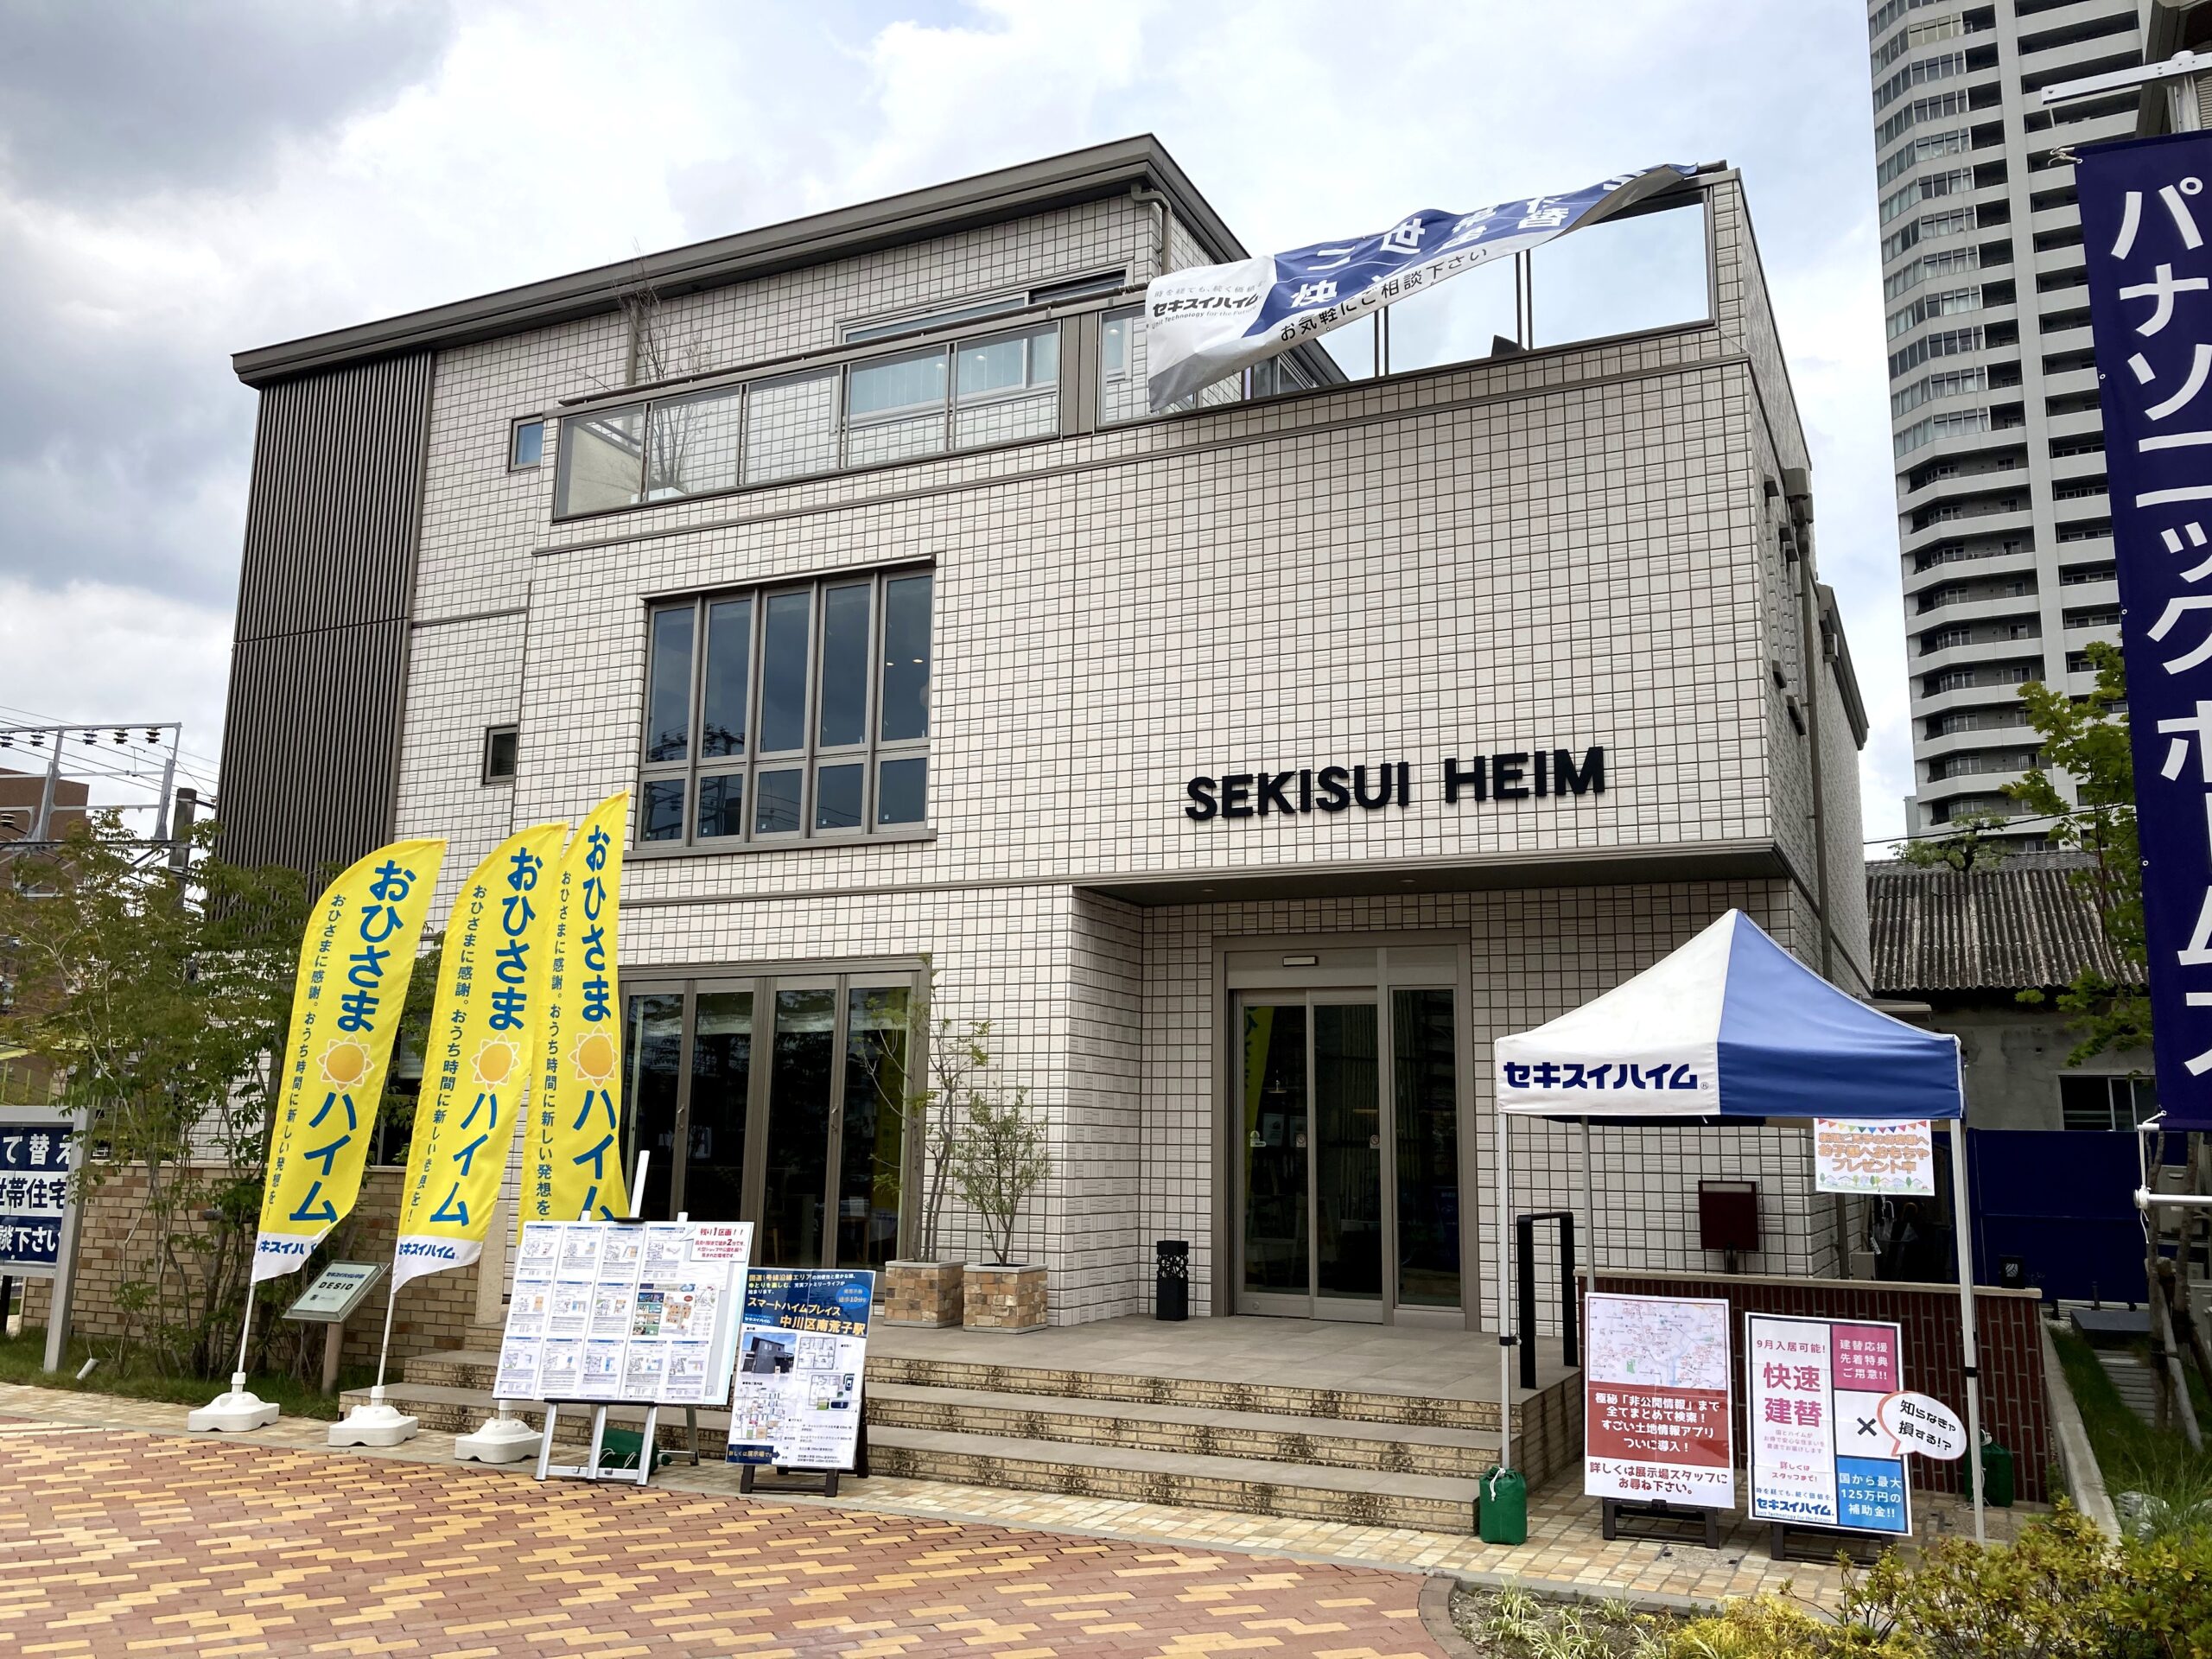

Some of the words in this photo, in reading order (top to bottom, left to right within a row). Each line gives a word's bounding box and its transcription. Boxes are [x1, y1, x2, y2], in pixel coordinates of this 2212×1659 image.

[1153, 293, 1260, 318] セキスイハイム
[1281, 248, 1487, 341] お気軽にご相談下さい
[1165, 311, 1205, 323] Technology
[1185, 761, 1410, 821] SEKISUI
[1445, 746, 1605, 804] HEIM
[582, 823, 612, 1023] おひさま
[337, 859, 417, 1033] おひさま
[488, 847, 543, 1031] おひさま
[1503, 1062, 1698, 1090] セキスイハイム
[289, 1091, 357, 1224] ハイム
[429, 1092, 498, 1227] ハイム
[318, 1281, 354, 1290] DESIO
[1840, 1339, 1888, 1353] 建替応援
[1840, 1353, 1889, 1367] 先着特典
[1763, 1362, 1821, 1393] 快速
[1595, 1392, 1719, 1412] 極秘「非公開情報」まで
[1764, 1397, 1822, 1428] 建替
[1900, 1399, 1956, 1432] 知らなきゃ
[1601, 1420, 1714, 1439] すごい土地情報アプリ
[1590, 1462, 1728, 1484] 詳しくは展示場スタッフに
[1780, 1461, 1810, 1471] 詳しくは
[1618, 1478, 1694, 1495] お尋ね下さい。
[1839, 1473, 1902, 1489] 国から最大
[1757, 1497, 1831, 1516] セキスイハイム
[1840, 1488, 1901, 1503] 125万円の
